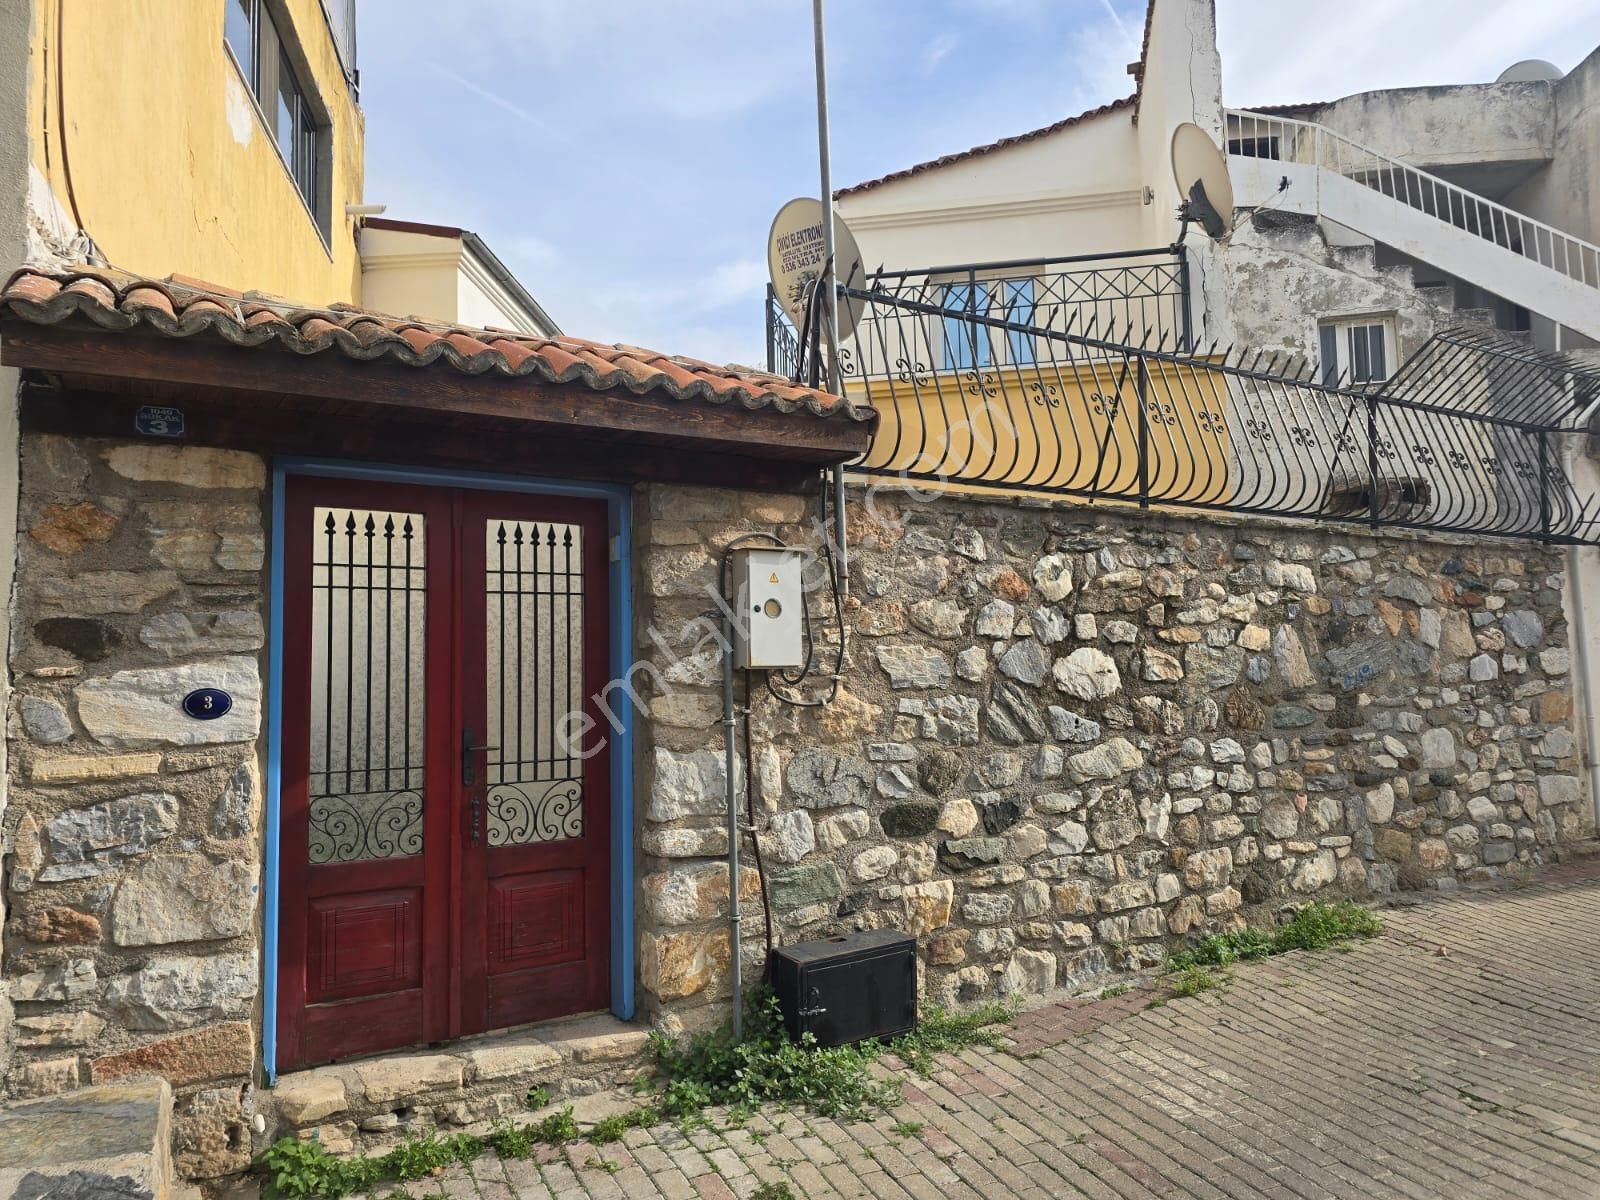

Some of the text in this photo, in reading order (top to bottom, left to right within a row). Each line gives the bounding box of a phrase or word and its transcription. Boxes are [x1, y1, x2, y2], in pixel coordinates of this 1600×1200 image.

[791, 221, 824, 247] ELEKTRONİ
[797, 256, 810, 268] 343
[811, 253, 821, 264] 24
[149, 420, 169, 433] 3
[204, 695, 213, 709] 3
